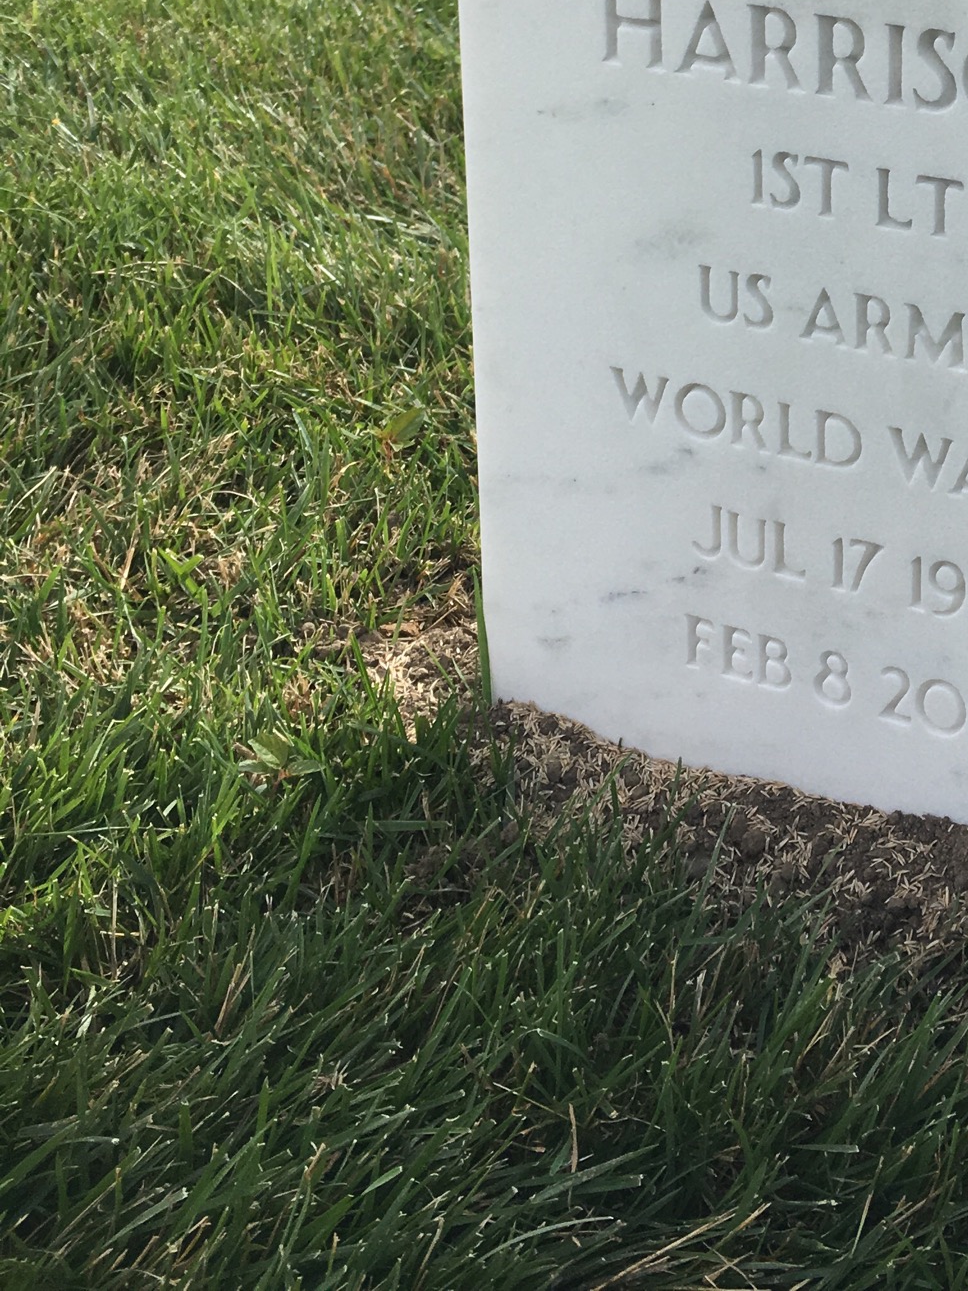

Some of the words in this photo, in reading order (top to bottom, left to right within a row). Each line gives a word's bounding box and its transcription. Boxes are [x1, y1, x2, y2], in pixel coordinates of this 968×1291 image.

[750, 147, 850, 216] 1ST
[874, 167, 964, 236] LT
[698, 264, 774, 330] US
[609, 366, 863, 468] WORLD
[692, 505, 806, 581] JUL
[830, 536, 884, 593] 17
[683, 613, 792, 690] FEB
[814, 650, 853, 708] 8
